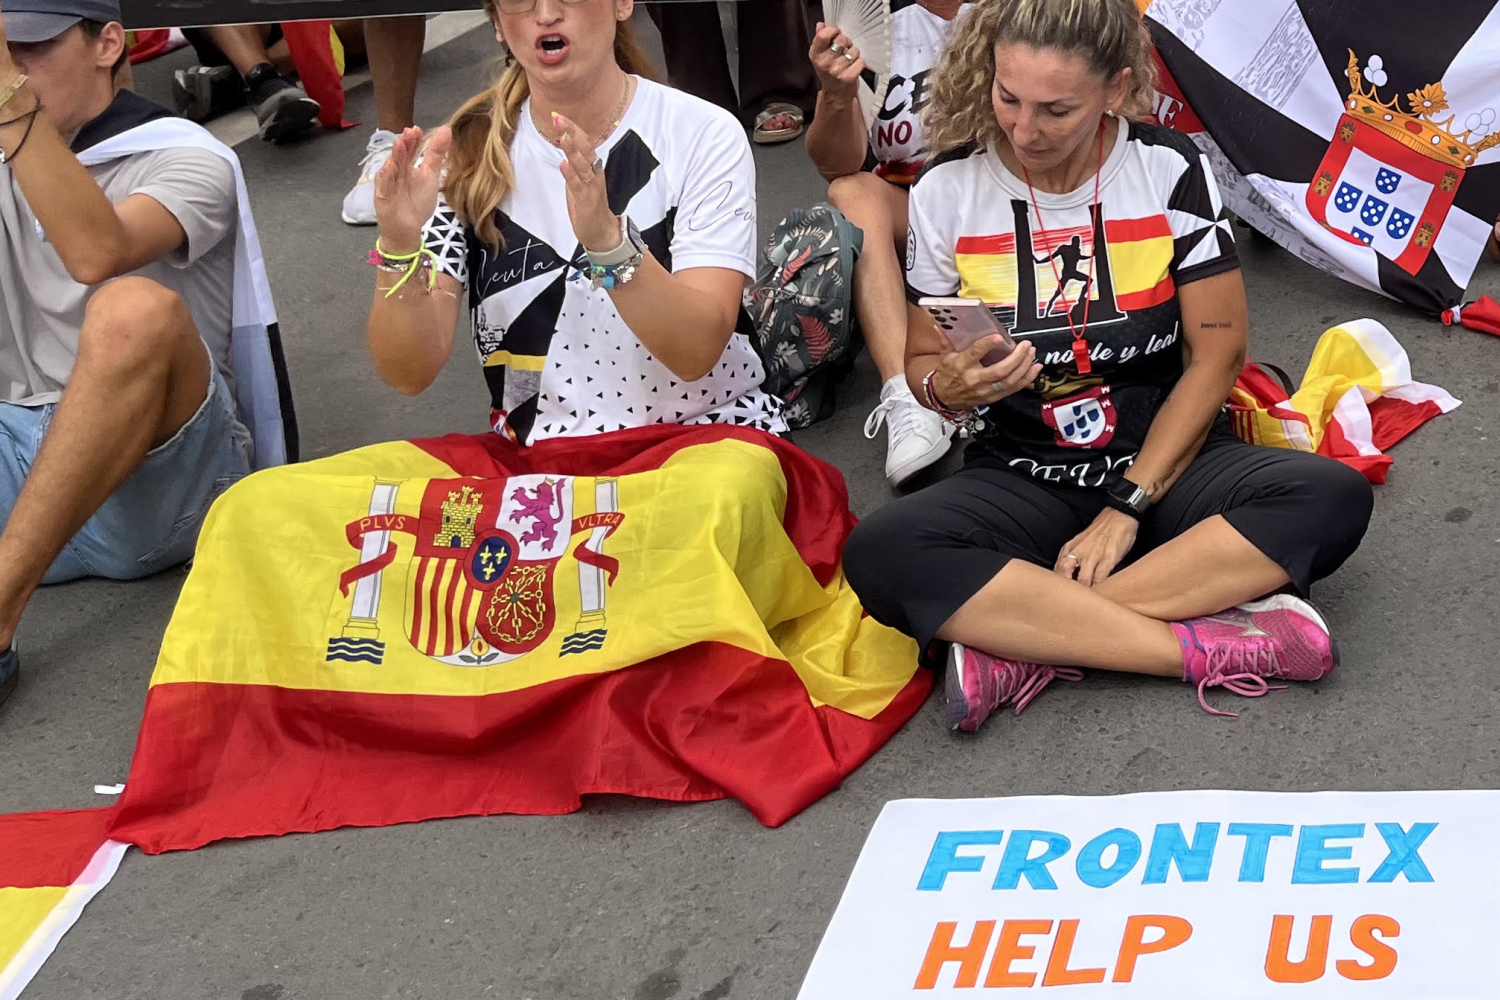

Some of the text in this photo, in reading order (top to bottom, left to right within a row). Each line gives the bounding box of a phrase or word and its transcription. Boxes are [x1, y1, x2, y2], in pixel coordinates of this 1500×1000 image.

[877, 120, 913, 149] NO
[689, 180, 755, 232] Ceu
[476, 239, 555, 301] Ceuta
[1044, 320, 1179, 365] nole y leal
[359, 515, 406, 531] PLVS
[578, 511, 621, 529] VLTRA
[916, 822, 1439, 891] FRONTEX
[913, 914, 1400, 990] HELP US
